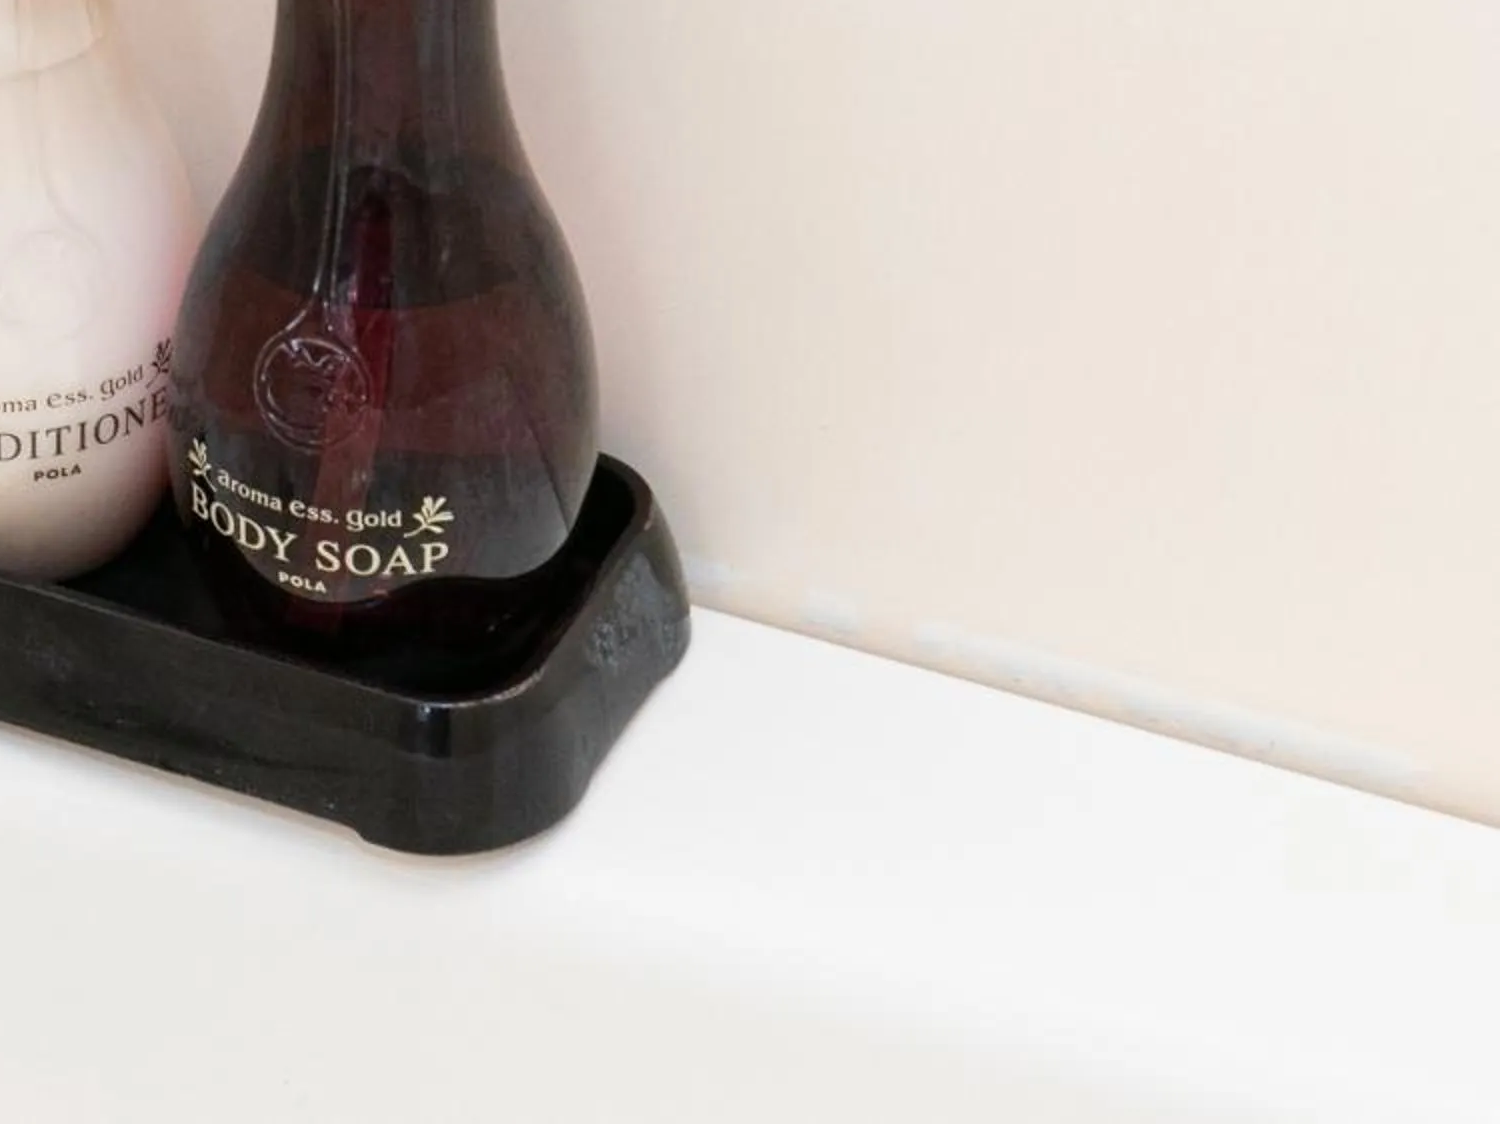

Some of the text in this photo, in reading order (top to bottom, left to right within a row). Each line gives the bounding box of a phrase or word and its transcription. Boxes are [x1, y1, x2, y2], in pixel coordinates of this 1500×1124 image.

[47, 390, 95, 410] ess.
[100, 364, 144, 402] gold
[33, 463, 83, 483] POLA
[217, 468, 402, 532] aroma ess. gold
[191, 480, 449, 576] BODY SOAP
[278, 572, 328, 595] POLA
